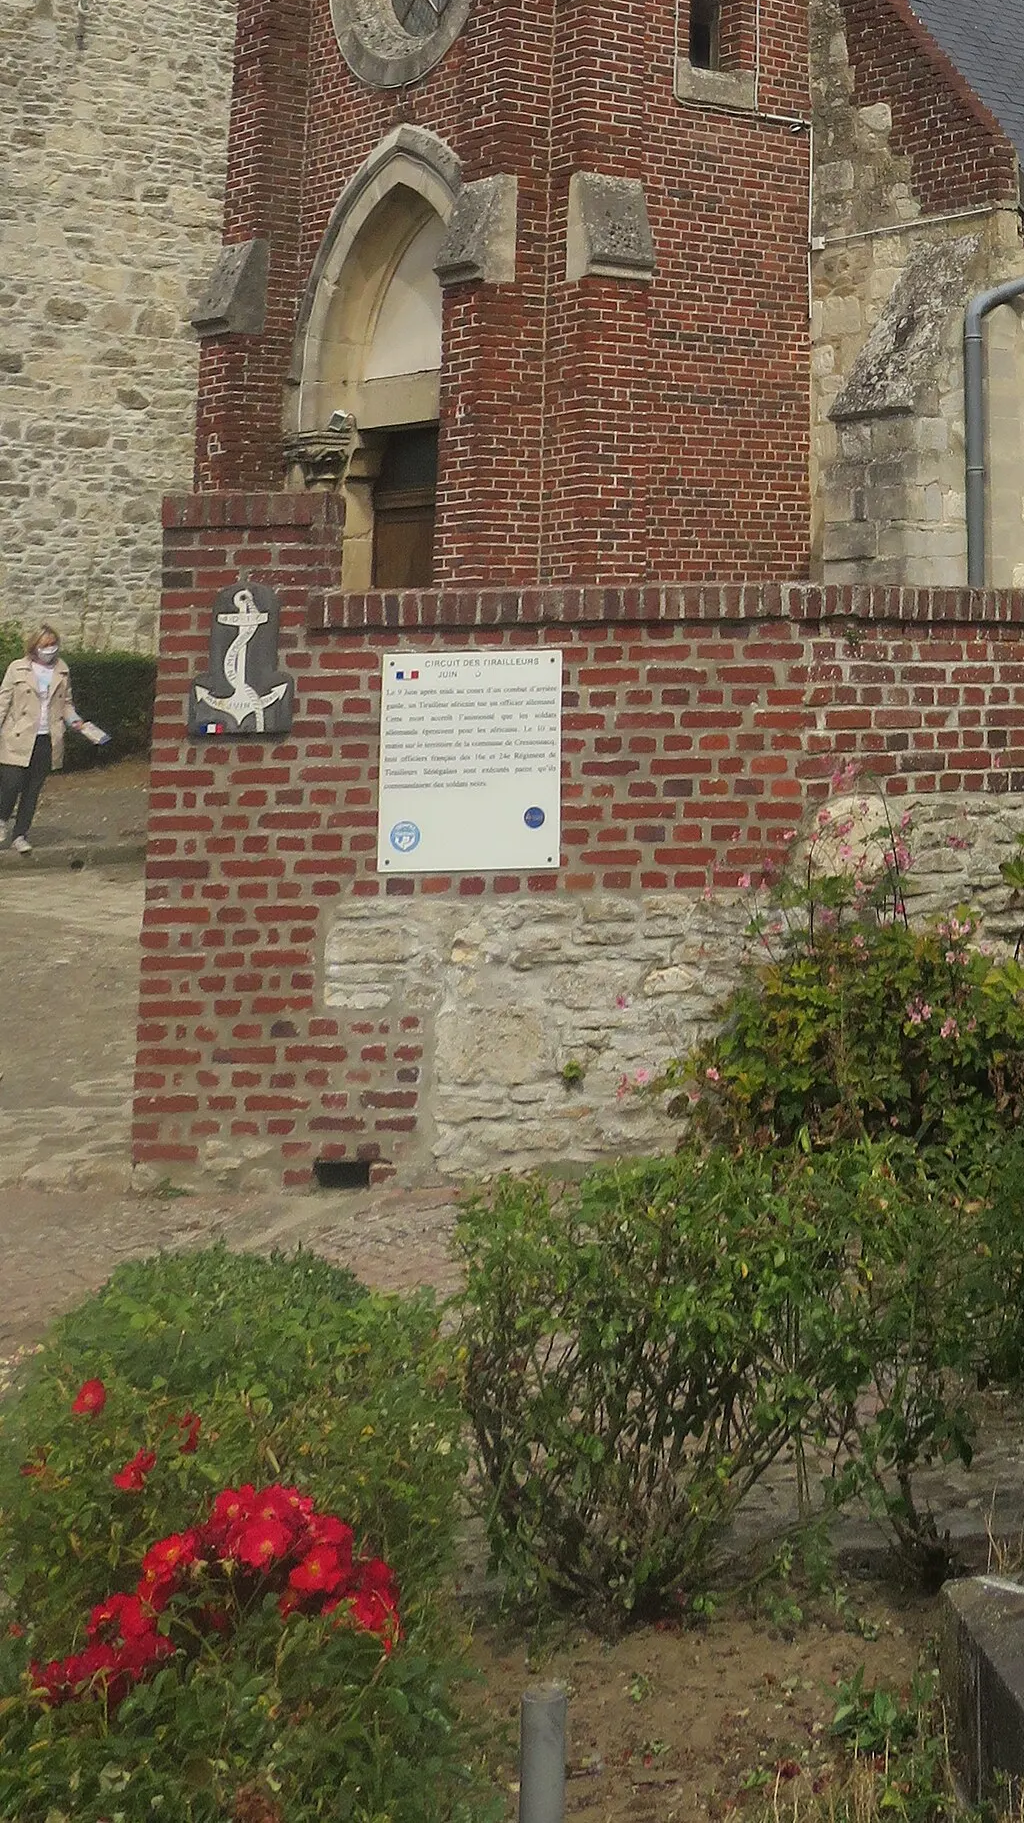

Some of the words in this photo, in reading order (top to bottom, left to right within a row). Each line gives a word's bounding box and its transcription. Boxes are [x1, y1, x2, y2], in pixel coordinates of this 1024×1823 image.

[424, 659, 460, 667] CIRCUIT
[462, 659, 480, 667] DES
[484, 657, 540, 666] TIRAILLEURS
